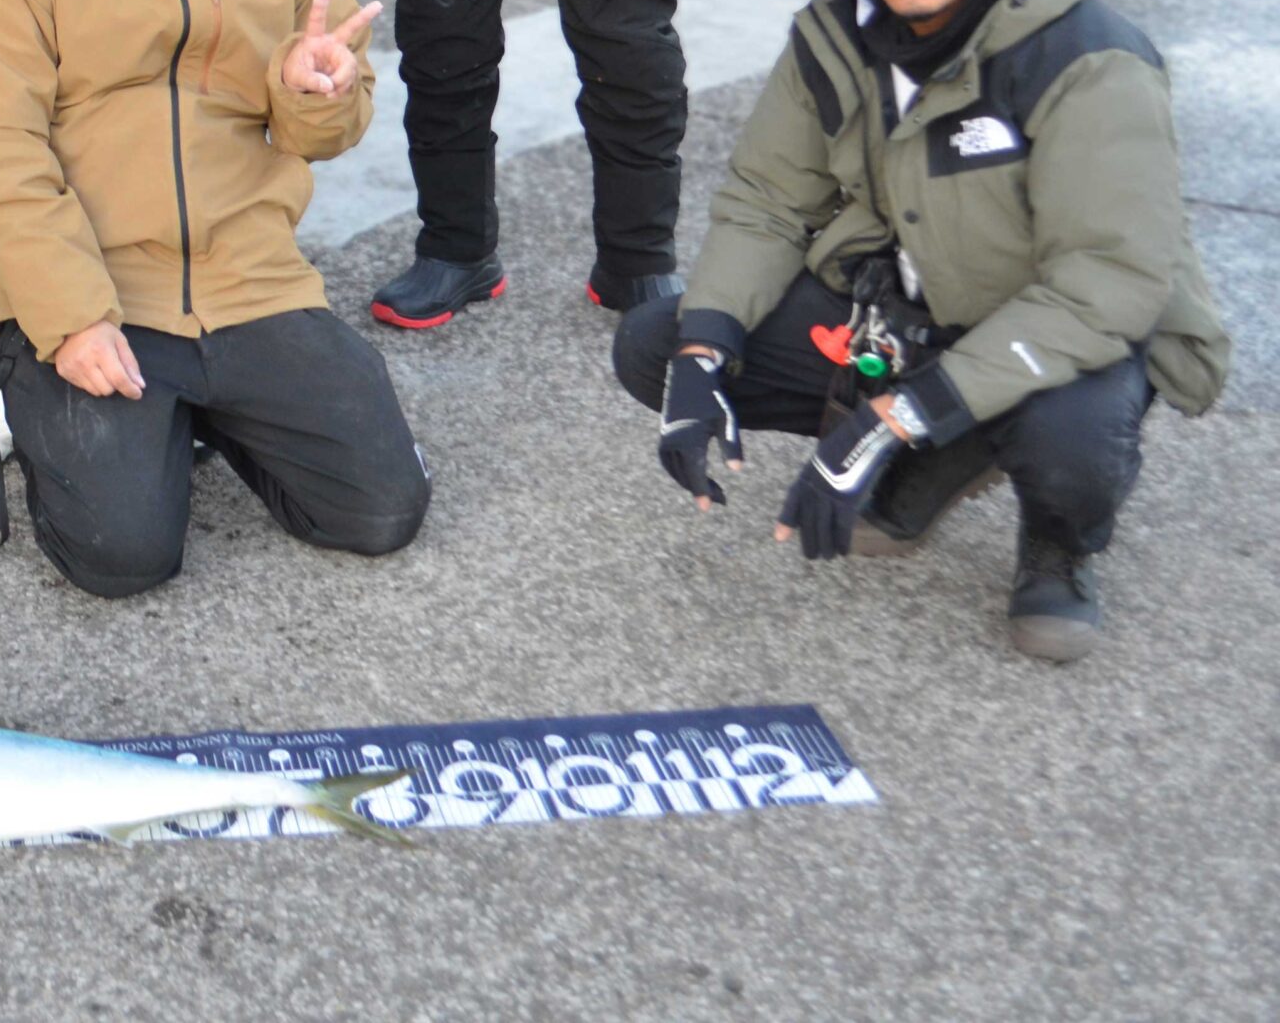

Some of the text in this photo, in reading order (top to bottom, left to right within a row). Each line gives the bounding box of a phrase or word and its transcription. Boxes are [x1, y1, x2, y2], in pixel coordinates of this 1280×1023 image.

[176, 732, 232, 750] SUNNY
[235, 733, 273, 746] SIDE
[277, 731, 346, 746] MARINA
[437, 759, 521, 825] 9
[517, 753, 636, 819] 10
[625, 747, 711, 813] 11
[702, 742, 826, 809] 12
